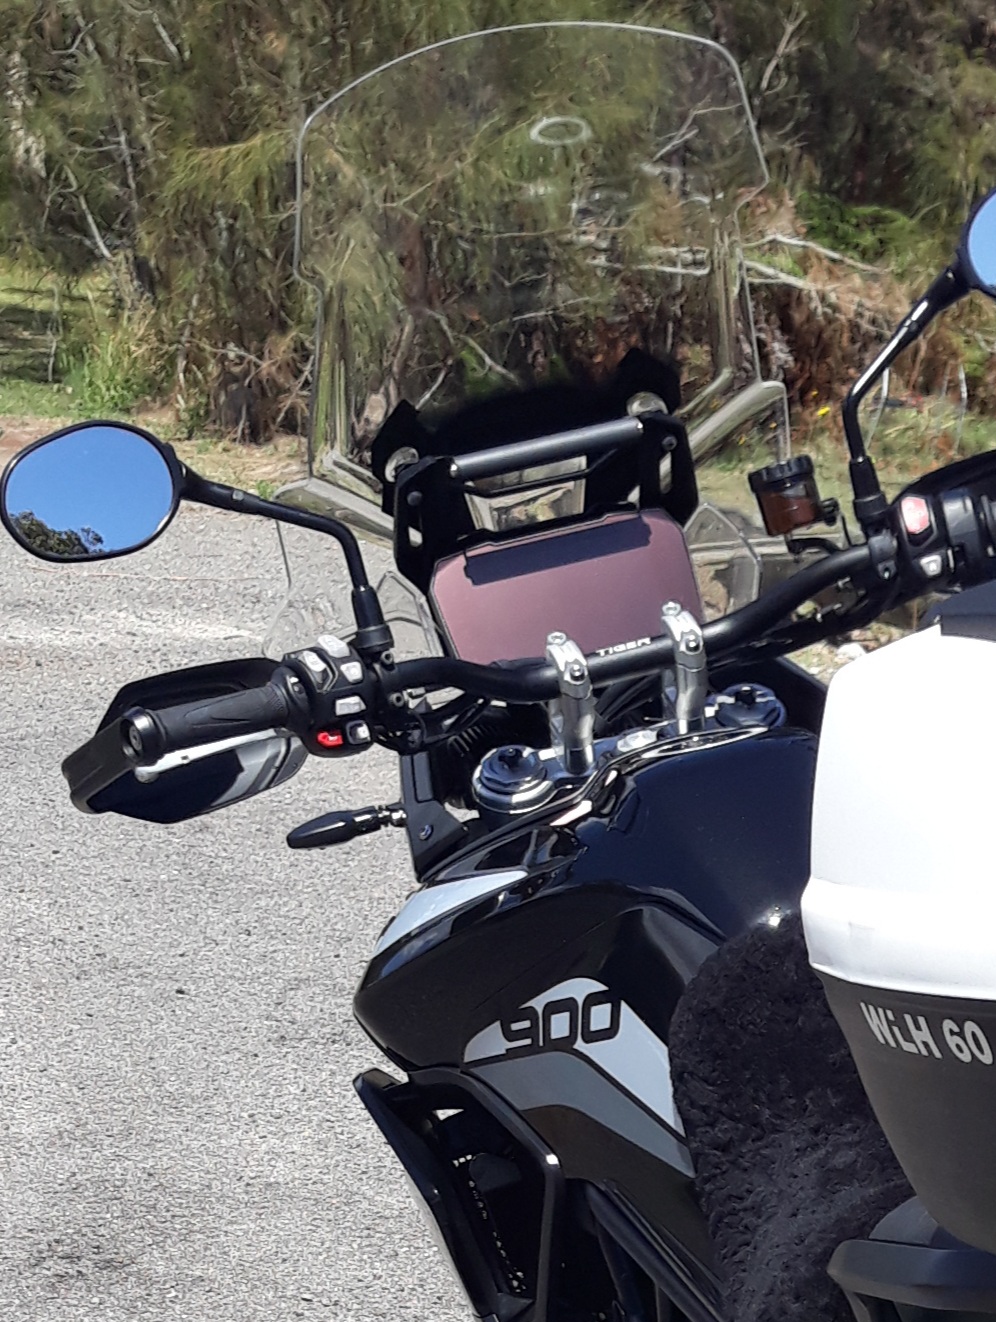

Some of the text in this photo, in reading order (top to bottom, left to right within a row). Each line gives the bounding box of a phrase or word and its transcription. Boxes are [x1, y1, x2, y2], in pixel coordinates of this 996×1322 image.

[595, 637, 651, 656] TIGER
[500, 991, 622, 1055] 900
[942, 1018, 993, 1065] 60
